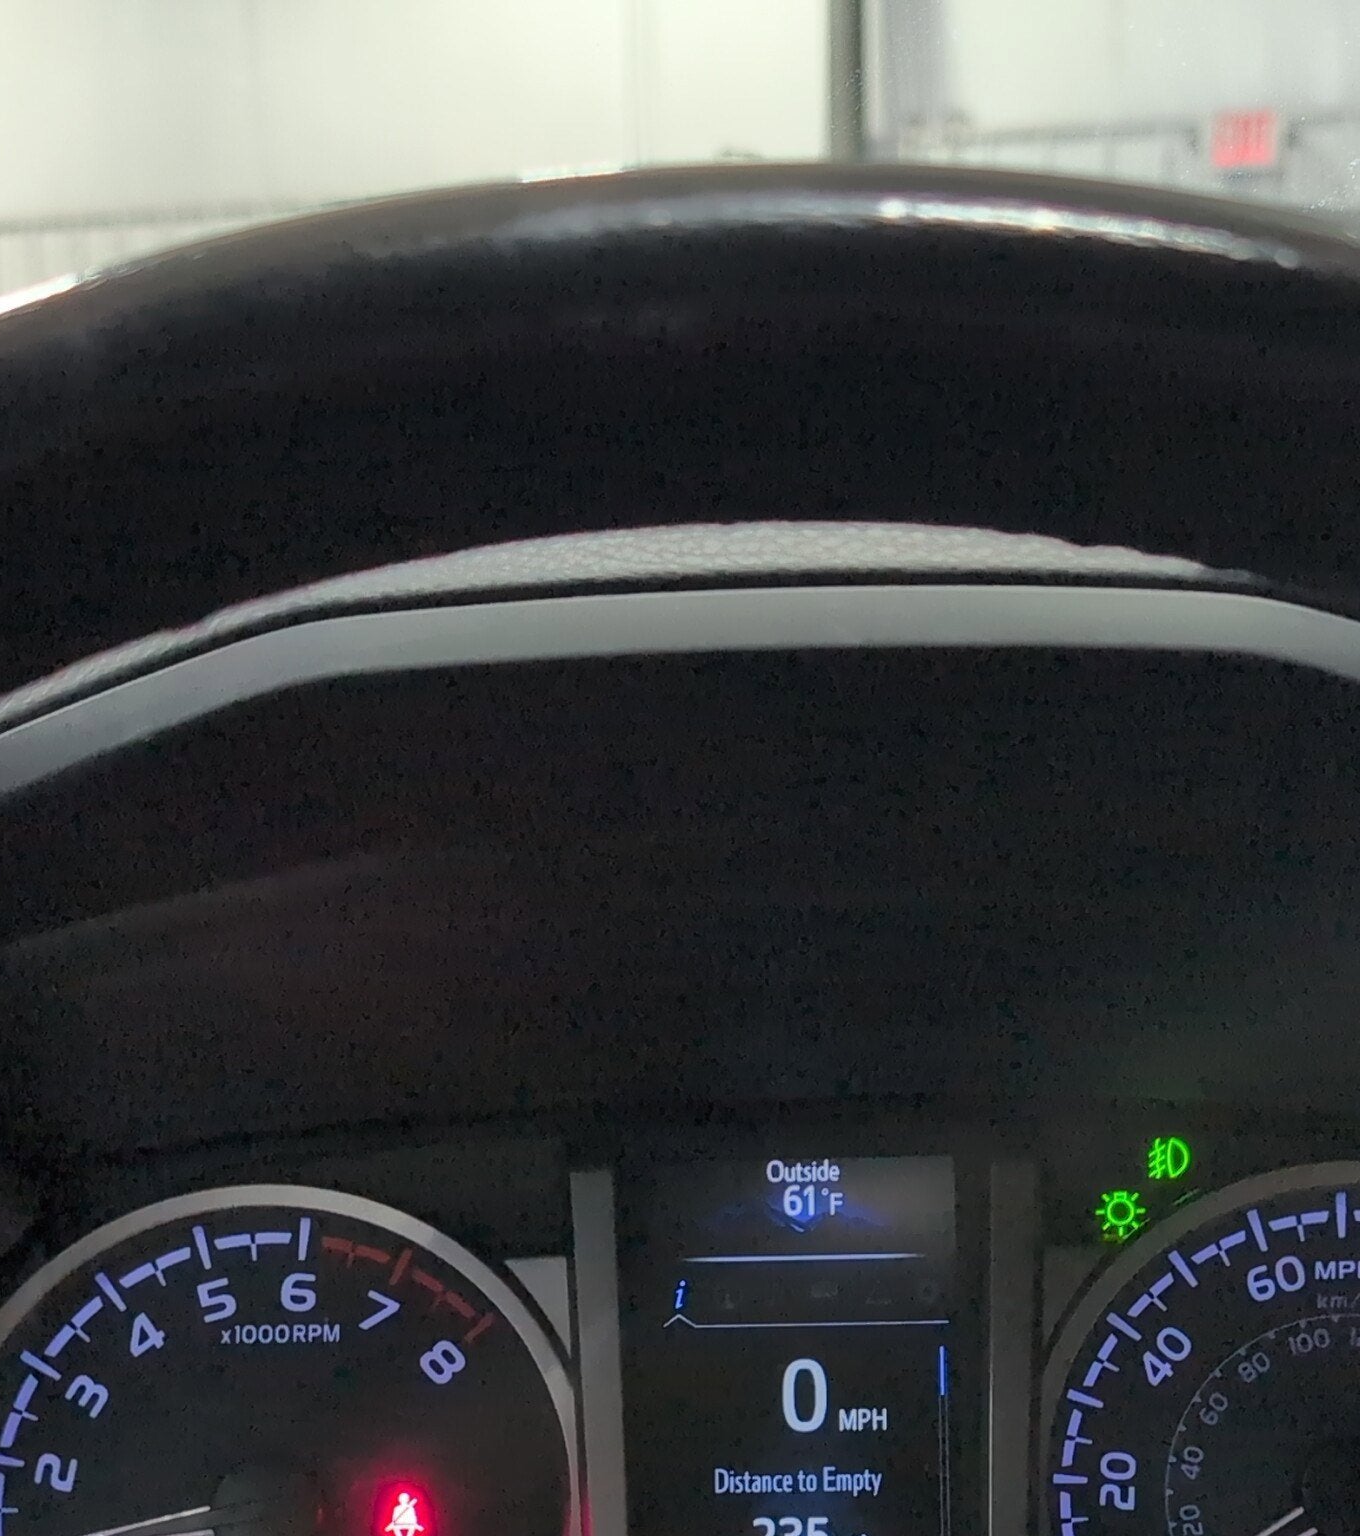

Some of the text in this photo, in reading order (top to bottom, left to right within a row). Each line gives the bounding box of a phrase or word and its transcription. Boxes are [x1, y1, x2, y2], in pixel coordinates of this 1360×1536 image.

[766, 1159, 840, 1183] Outside
[782, 1184, 844, 1217] 61°F
[279, 1272, 317, 1313] 6
[1246, 1255, 1306, 1303] 60
[196, 1277, 238, 1323] 5
[358, 1289, 401, 1331] 7
[129, 1313, 166, 1357] 4
[1287, 1327, 1332, 1356] 100
[419, 1339, 466, 1385] 8
[1142, 1326, 1193, 1387] 40
[1238, 1351, 1272, 1384] 80
[65, 1373, 110, 1419] 3
[782, 1358, 888, 1433] 0 MPH
[1199, 1391, 1229, 1426] 60
[34, 1453, 78, 1492] 2
[714, 1467, 882, 1497] Distance to Empty
[1099, 1451, 1137, 1511] 20
[1180, 1445, 1205, 1481] 40
[1179, 1504, 1204, 1536] 20
